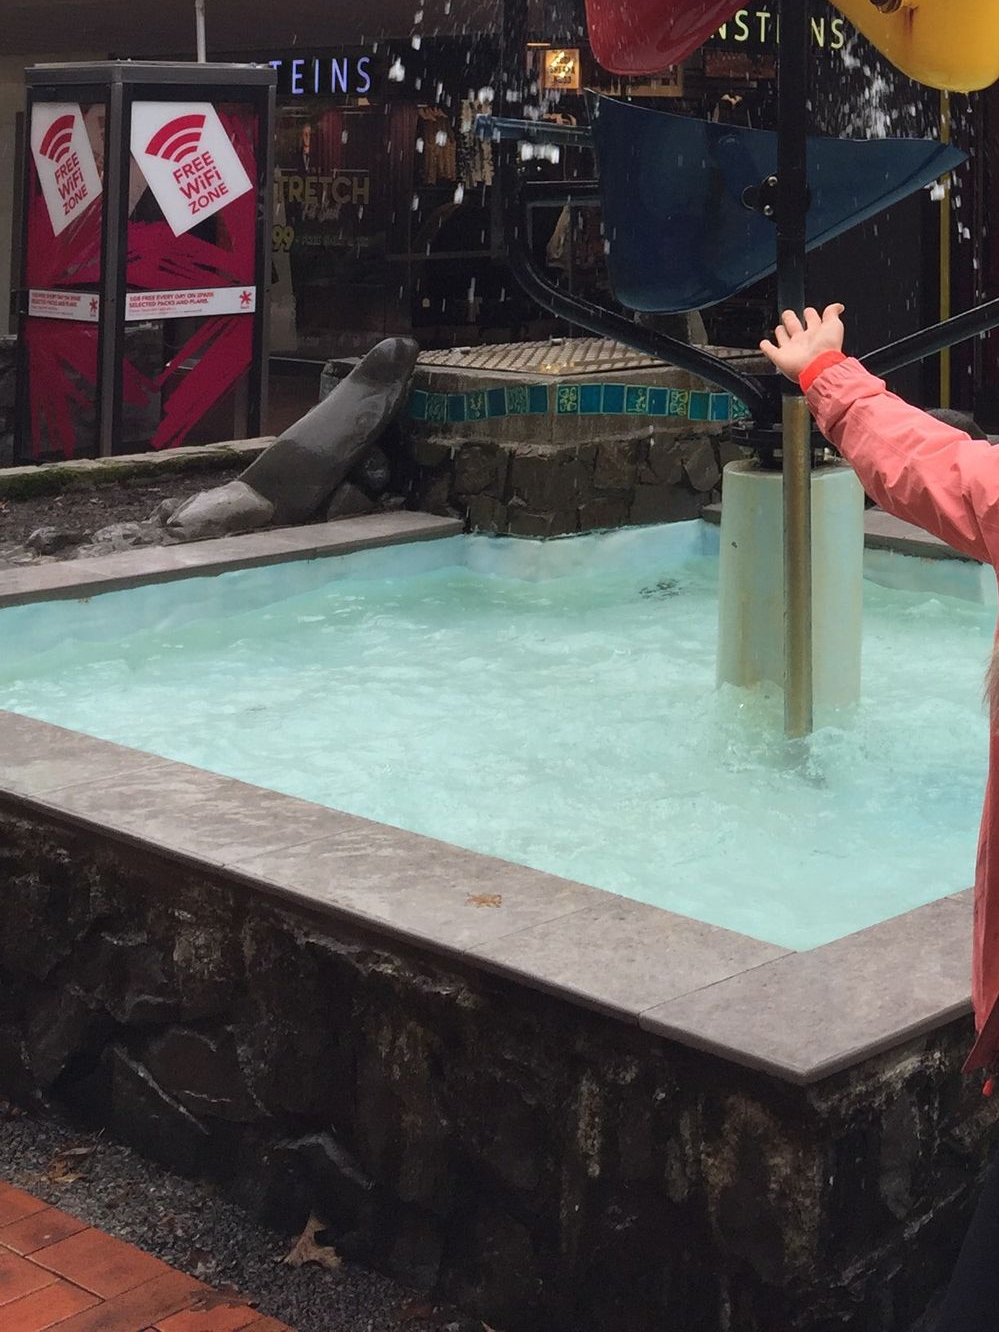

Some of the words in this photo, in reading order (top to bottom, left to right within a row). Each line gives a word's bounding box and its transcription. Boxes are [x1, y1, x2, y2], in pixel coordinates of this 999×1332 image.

[54, 151, 80, 183] FREE
[58, 167, 85, 200] WiFi
[172, 151, 214, 185] FREE
[179, 166, 222, 200] WiFi
[62, 184, 88, 216] ZONE
[187, 182, 229, 215] ZONE
